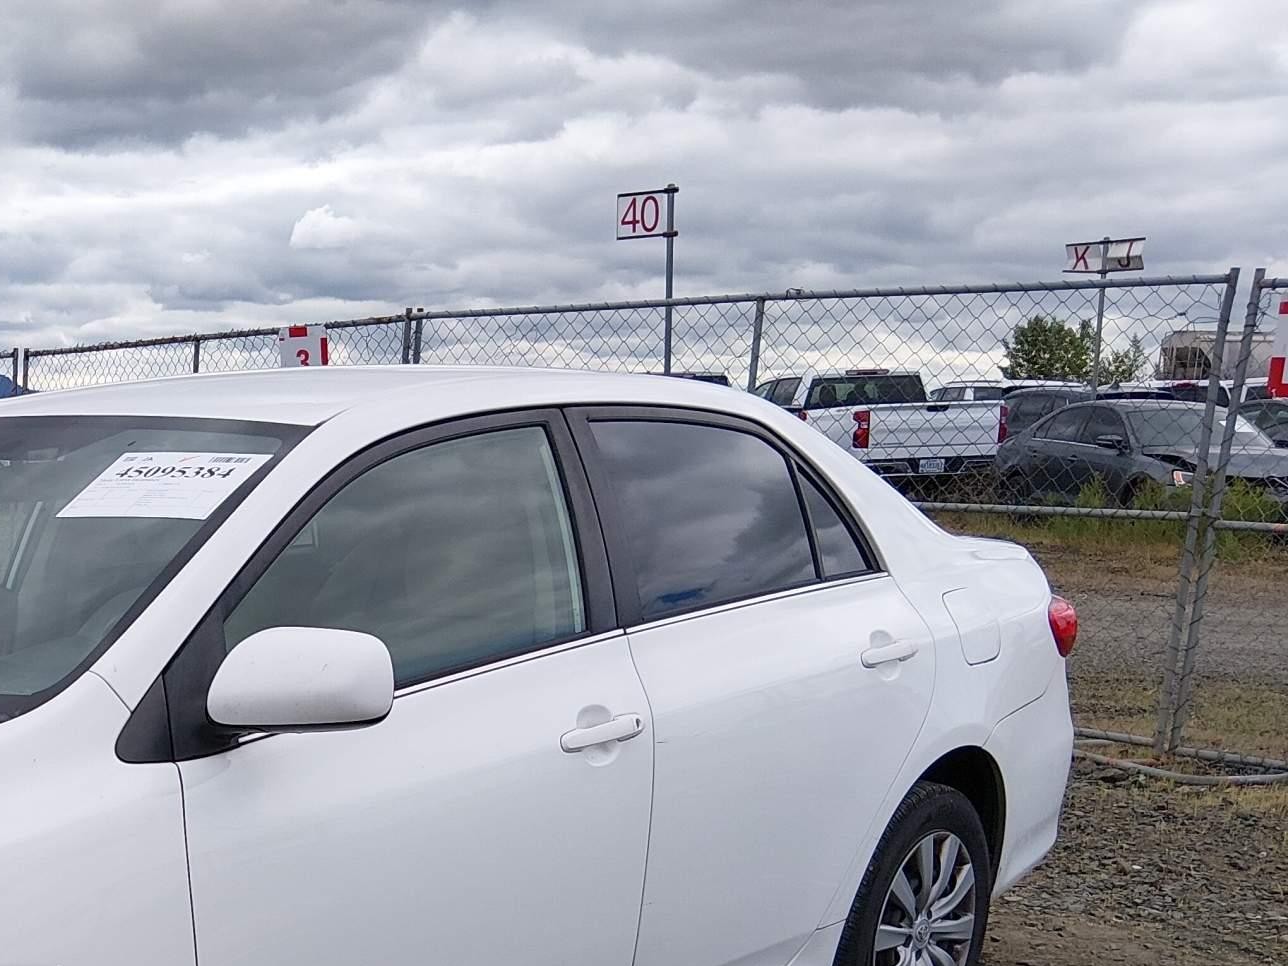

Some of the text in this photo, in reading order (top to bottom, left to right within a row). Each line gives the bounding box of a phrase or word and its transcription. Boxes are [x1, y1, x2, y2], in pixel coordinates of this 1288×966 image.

[620, 196, 660, 233] 40
[1117, 240, 1134, 268] J
[115, 465, 237, 479] 45095384
